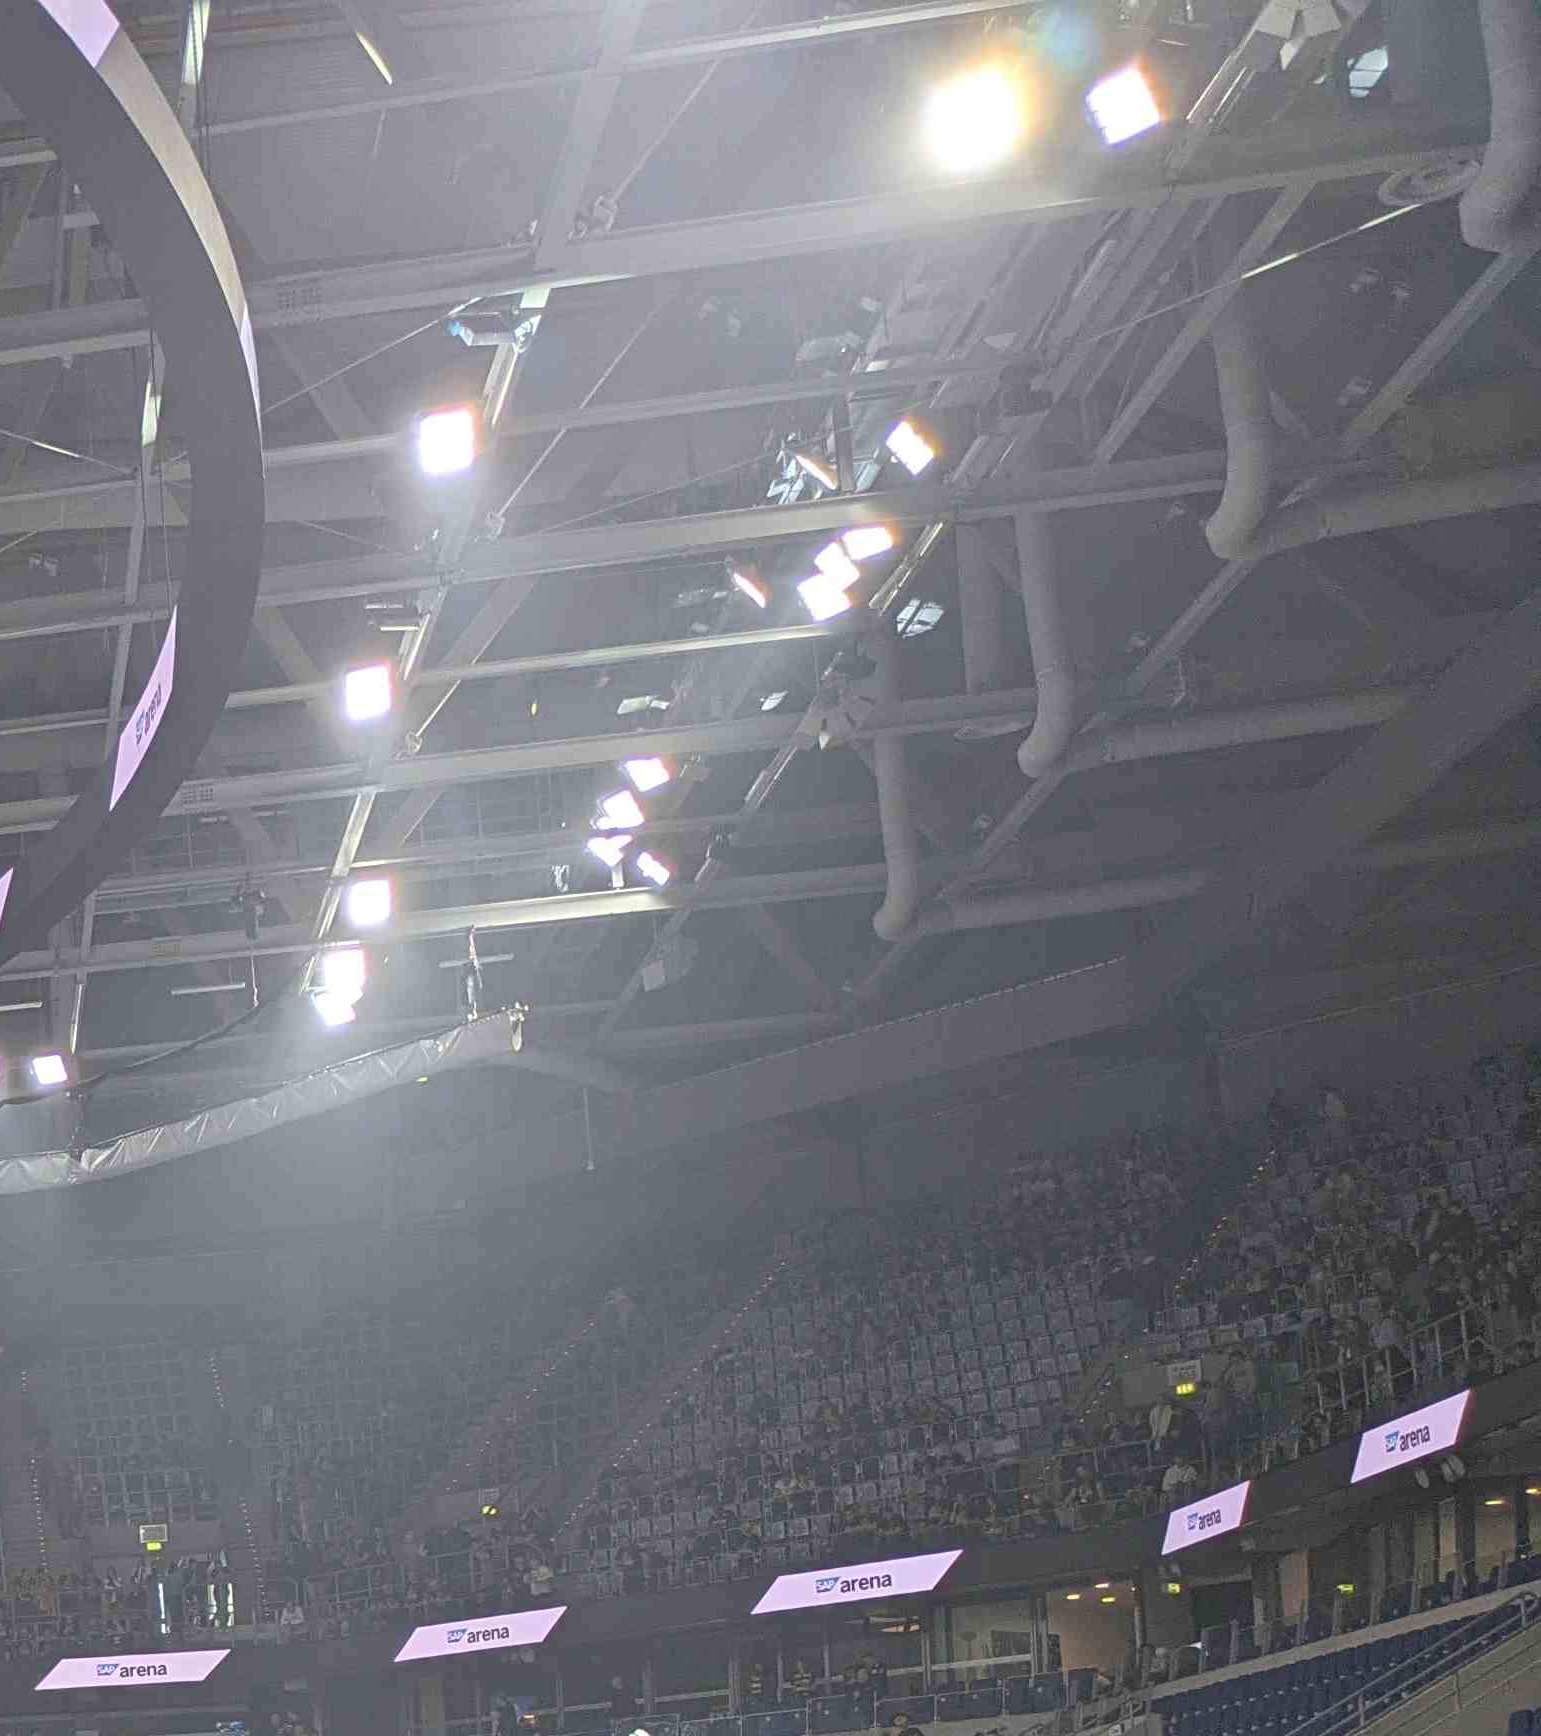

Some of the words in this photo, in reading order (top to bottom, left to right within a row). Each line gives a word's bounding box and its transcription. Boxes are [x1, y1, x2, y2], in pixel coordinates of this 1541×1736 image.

[1399, 1424, 1432, 1451] arena
[1198, 1507, 1223, 1531] arena
[839, 1571, 893, 1595] arena
[466, 1624, 510, 1645] arena
[119, 1661, 168, 1680] arena
